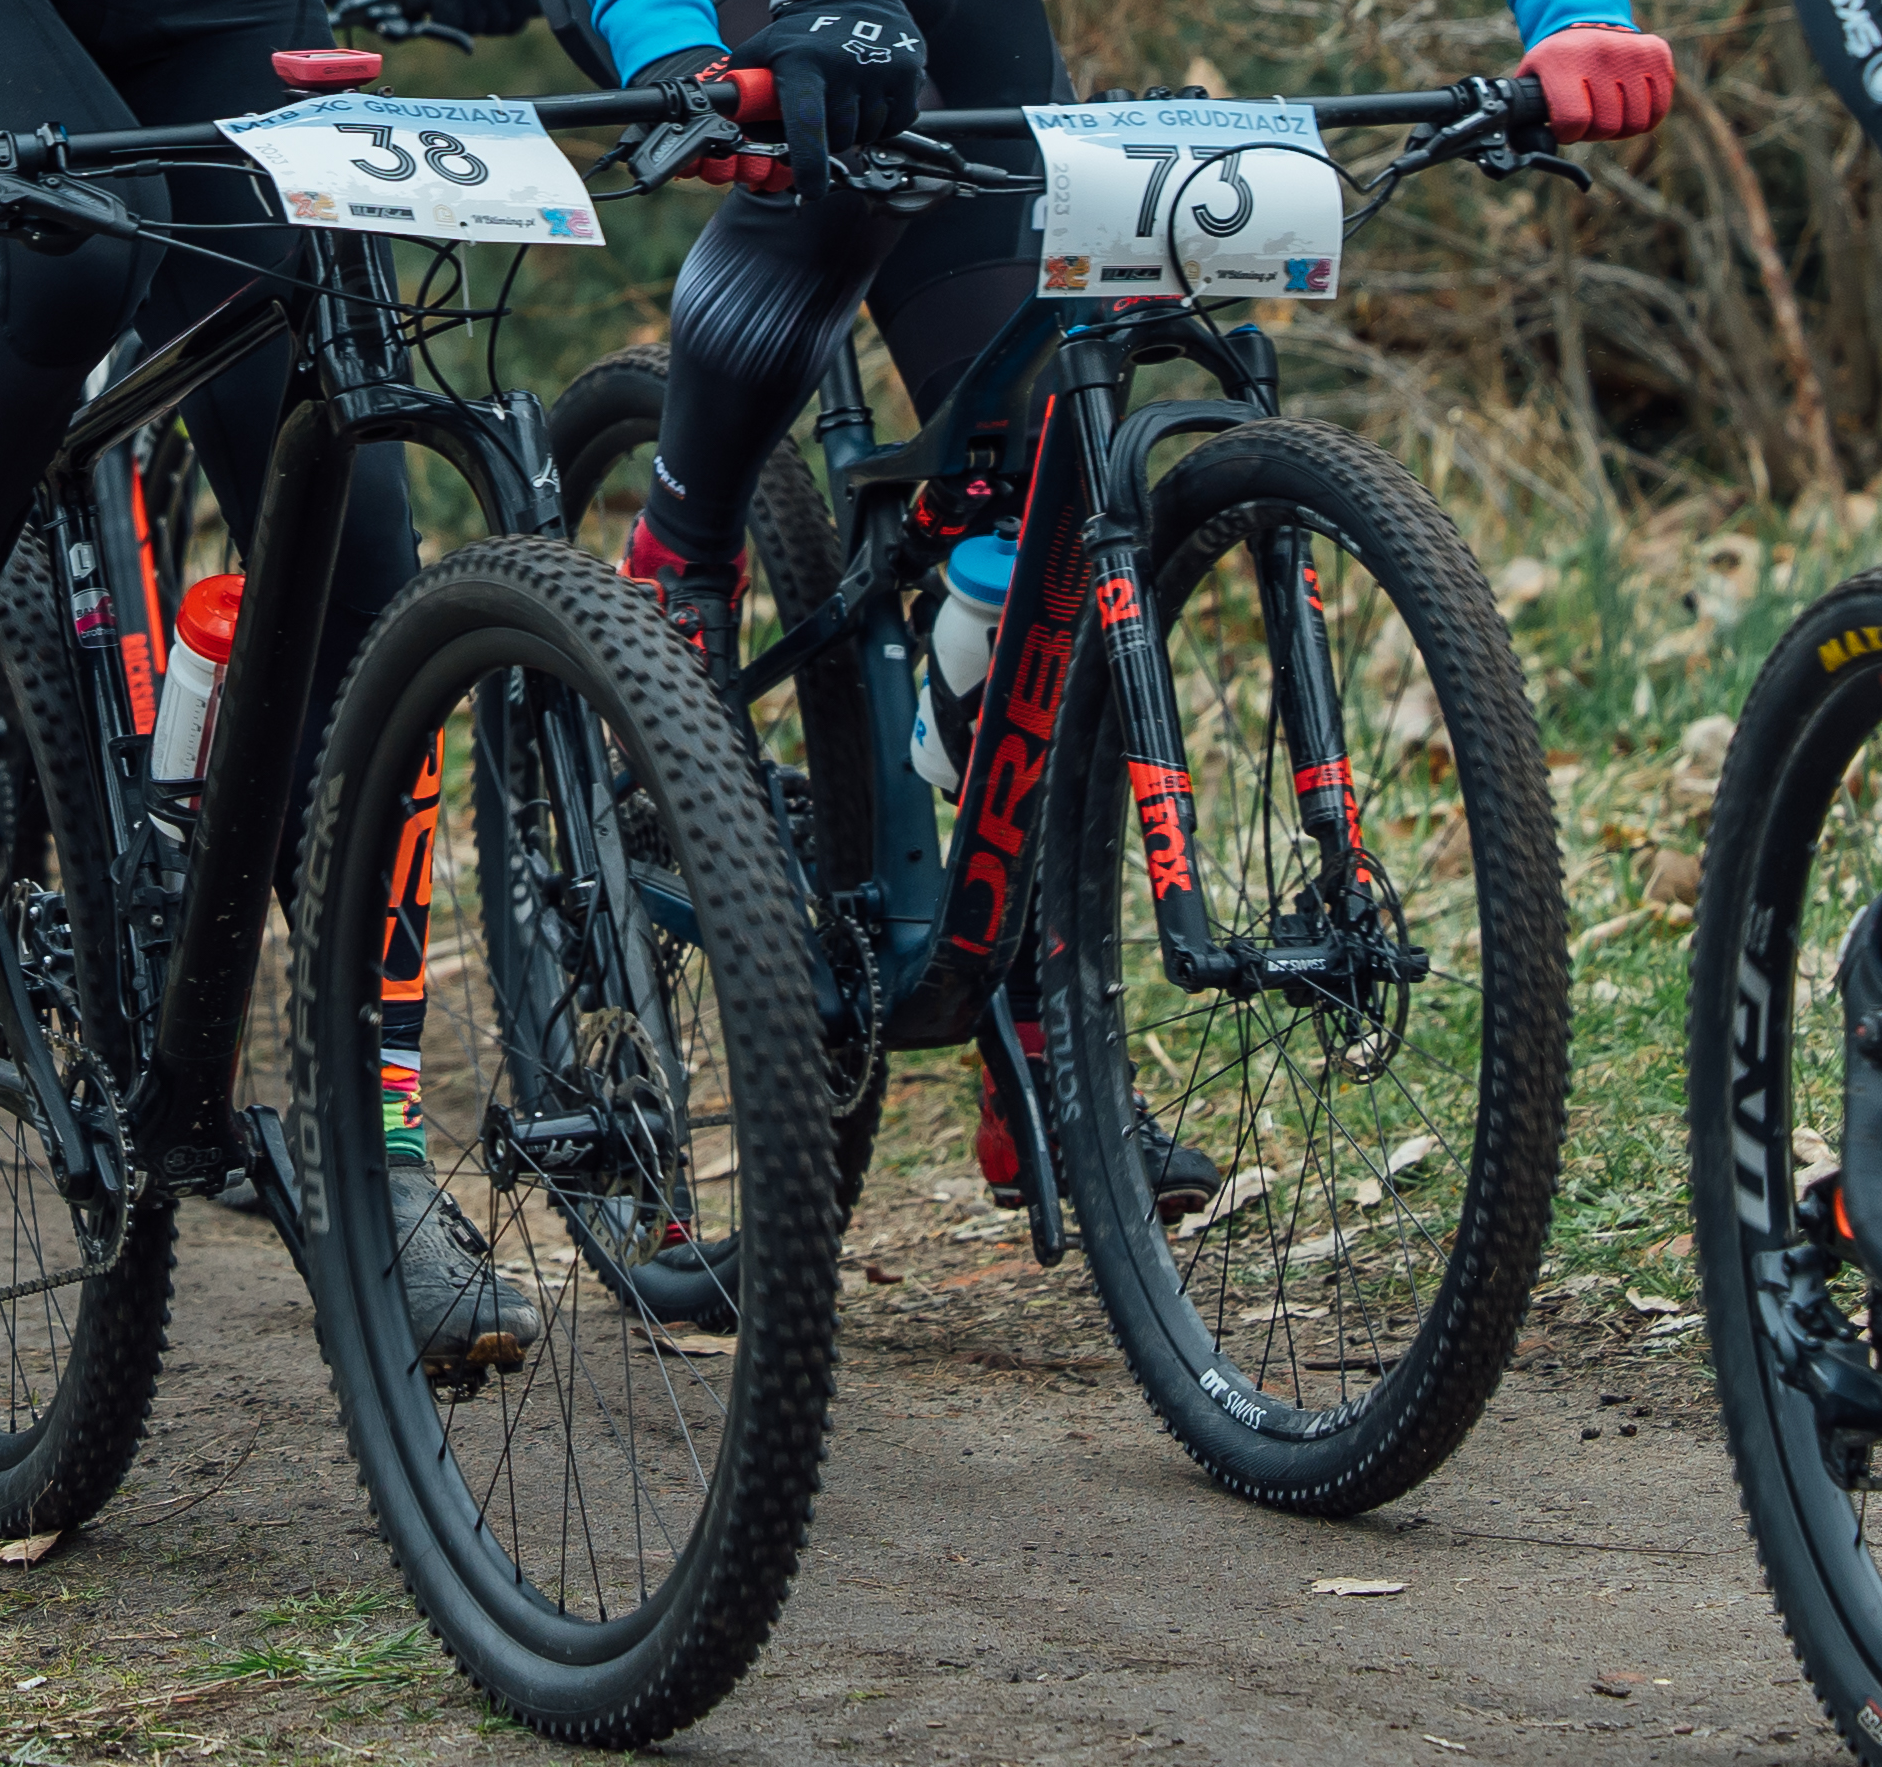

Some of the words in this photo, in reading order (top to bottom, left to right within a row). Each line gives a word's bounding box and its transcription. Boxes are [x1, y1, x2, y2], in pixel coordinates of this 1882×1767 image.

[808, 16, 921, 53] FOX
[229, 109, 301, 134] MTB
[308, 99, 353, 113] XC
[1035, 113, 1099, 130] MTB
[1107, 110, 1148, 127] XC
[333, 122, 490, 187] 38
[1053, 162, 1072, 217] 2023
[1122, 143, 1254, 239] 73
[1141, 796, 1193, 901] FOX
[1056, 986, 1085, 1123] SCYLLA
[1200, 1367, 1231, 1399] DT
[1222, 1389, 1268, 1431] SWISS
